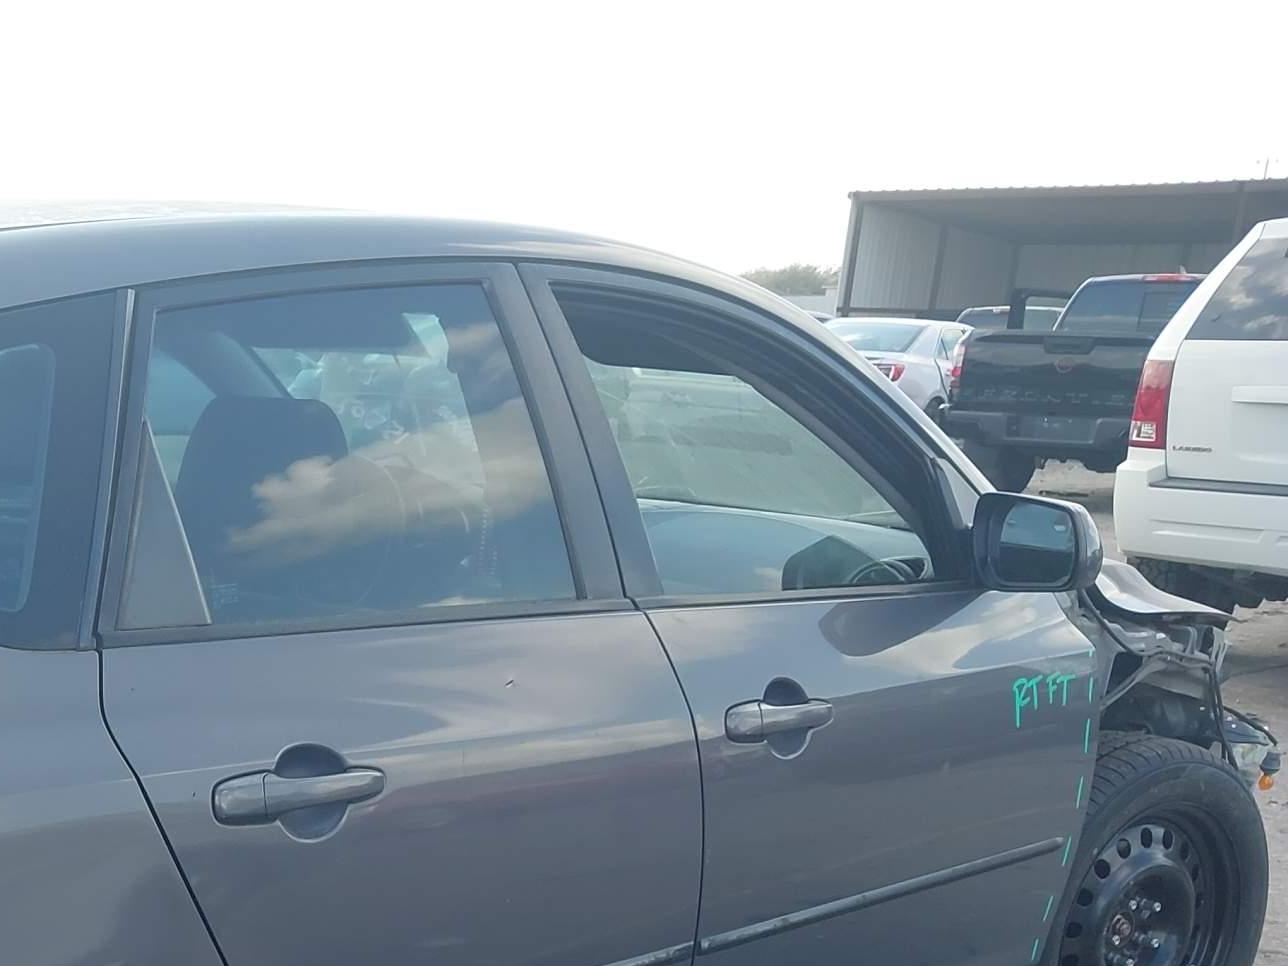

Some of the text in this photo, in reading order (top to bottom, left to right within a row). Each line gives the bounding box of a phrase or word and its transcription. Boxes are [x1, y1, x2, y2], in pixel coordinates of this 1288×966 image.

[978, 389, 1132, 406] FRONTE
[1012, 671, 1076, 729] RT FT
